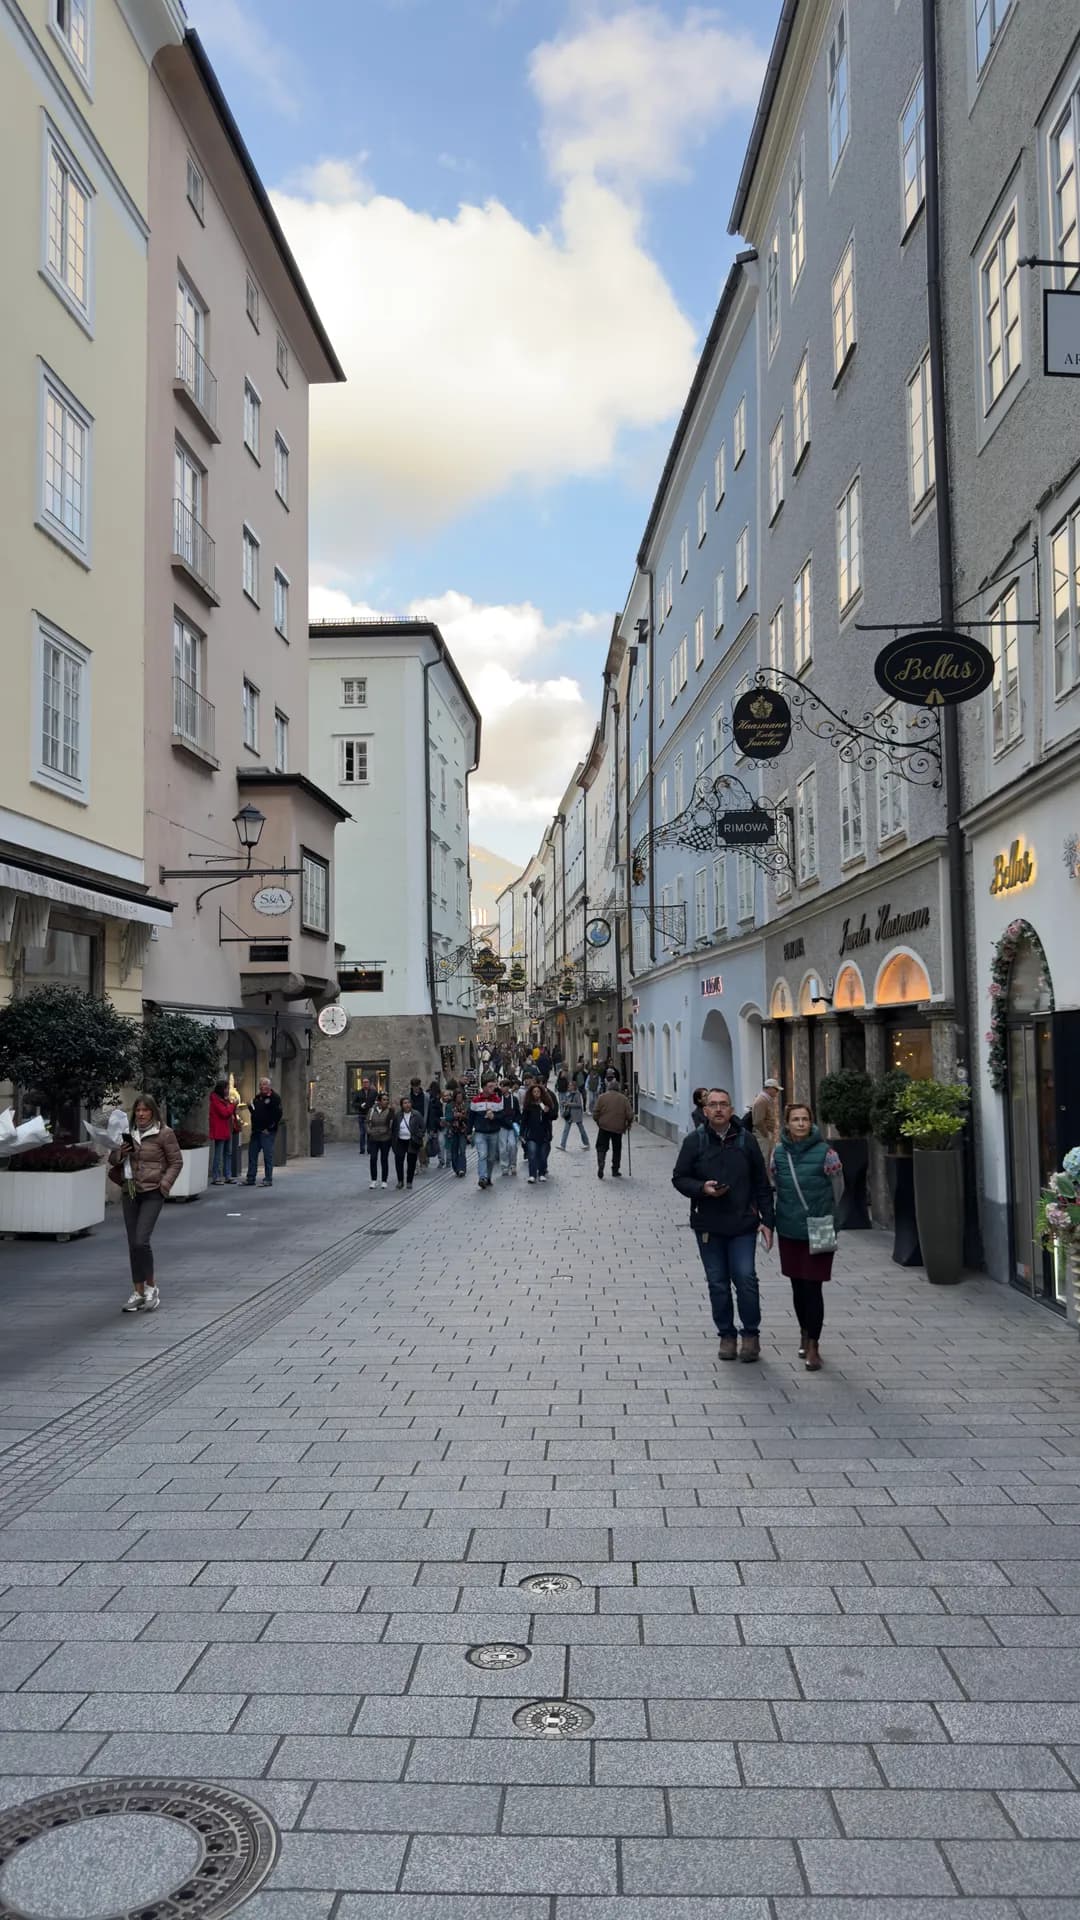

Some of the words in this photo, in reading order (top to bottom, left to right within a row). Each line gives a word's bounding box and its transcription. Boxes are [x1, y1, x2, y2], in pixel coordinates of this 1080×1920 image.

[894, 653, 976, 680] Bellas
[724, 822, 769, 832] RIMOWA
[989, 839, 1033, 895] Bellas
[260, 894, 286, 904] S&A
